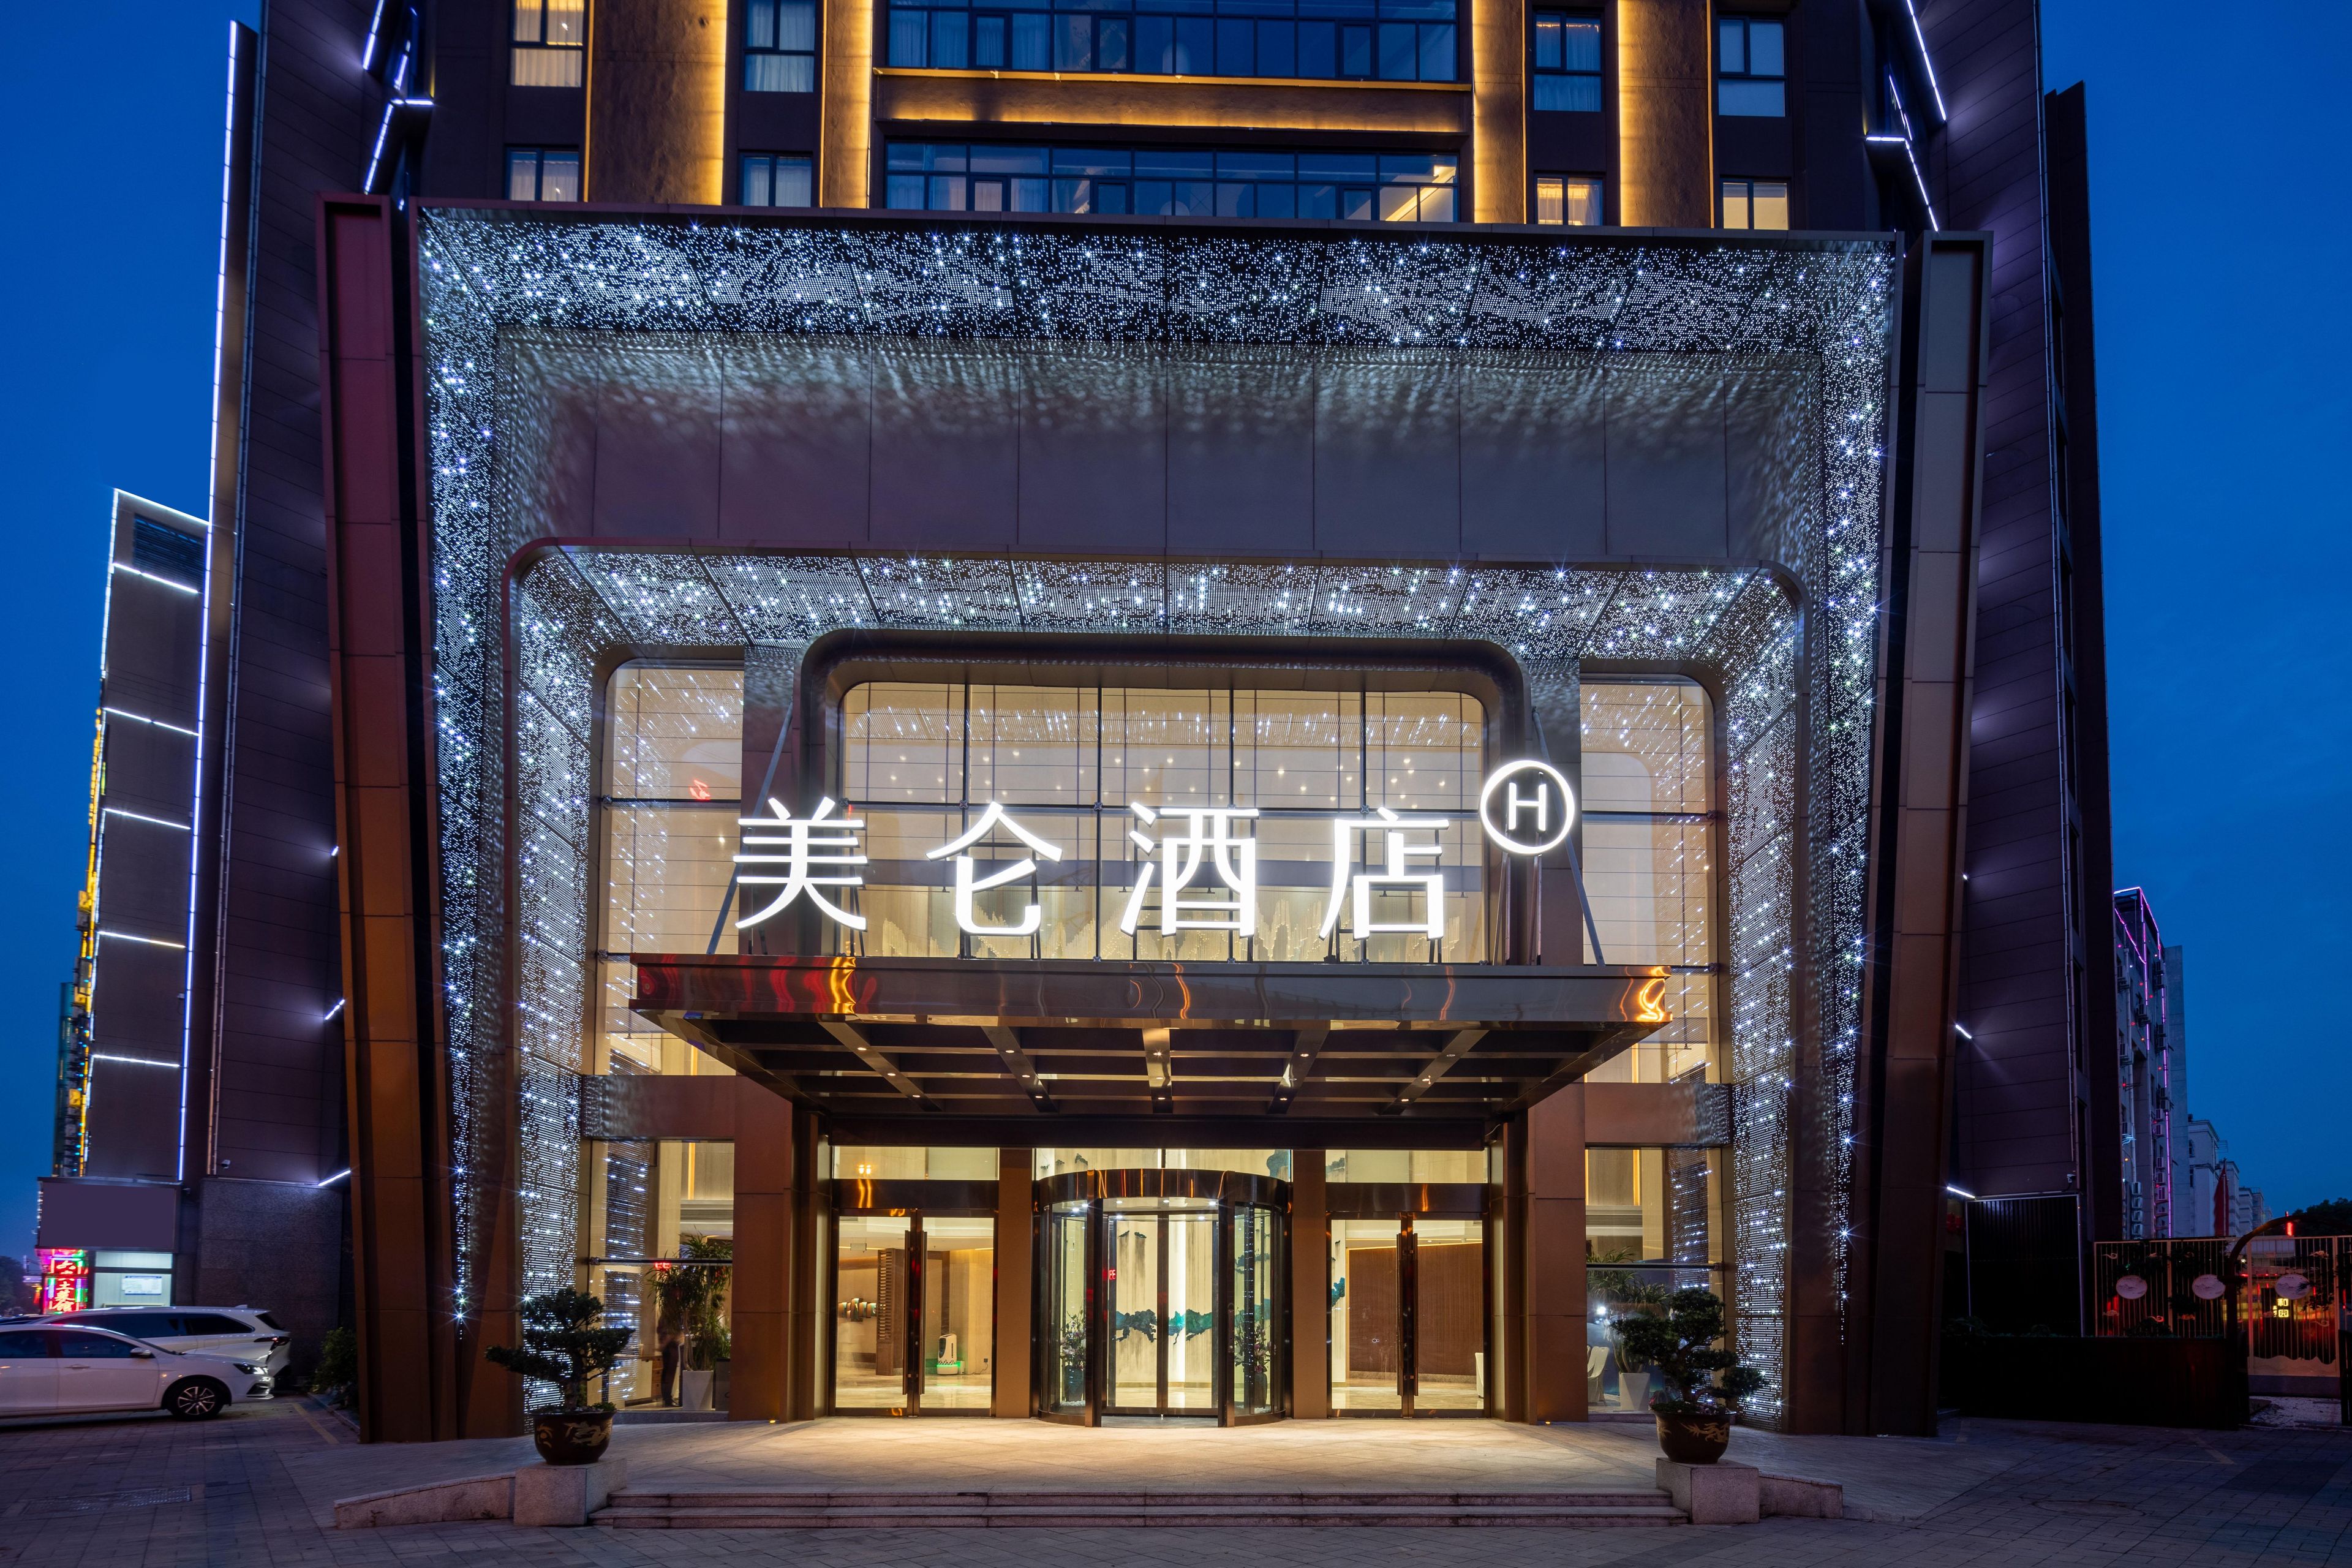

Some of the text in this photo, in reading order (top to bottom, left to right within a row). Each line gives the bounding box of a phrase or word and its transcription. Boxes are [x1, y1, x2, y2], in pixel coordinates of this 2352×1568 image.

[734, 796, 1450, 939] 美仑酒店
[2277, 1298, 2289, 1317] 和园
